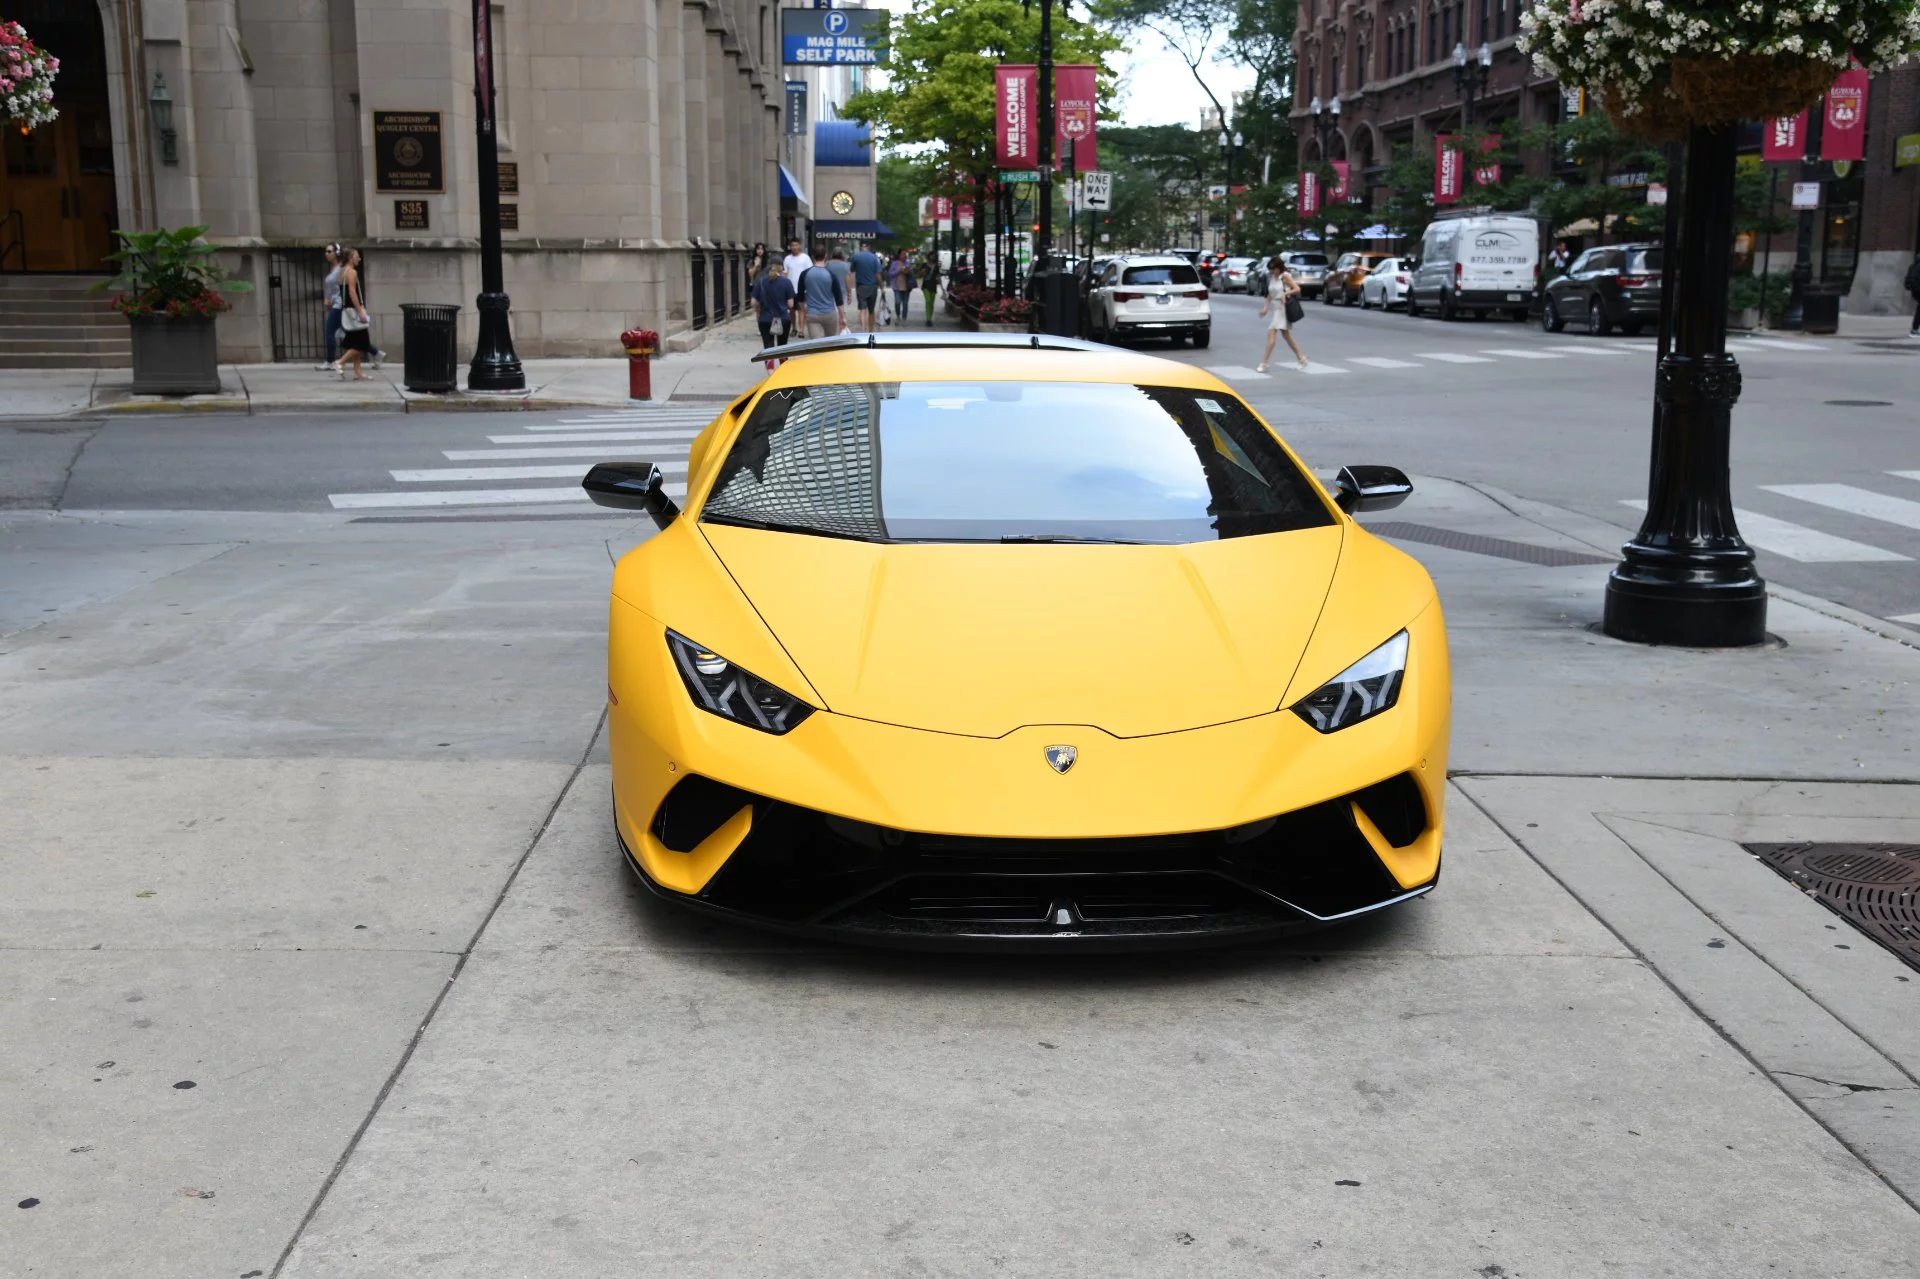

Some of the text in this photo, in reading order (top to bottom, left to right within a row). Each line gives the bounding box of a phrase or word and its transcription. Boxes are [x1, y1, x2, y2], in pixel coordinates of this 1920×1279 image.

[830, 14, 843, 31] P
[806, 37, 866, 47] MAG MILE
[796, 49, 877, 61] SELF PARK
[1006, 77, 1020, 157] WELCOME
[376, 125, 408, 133] QUIGLEY
[1007, 173, 1029, 181] RUSH
[1088, 175, 1108, 185] ONE
[1086, 186, 1108, 195] WAY
[401, 203, 423, 214] 835
